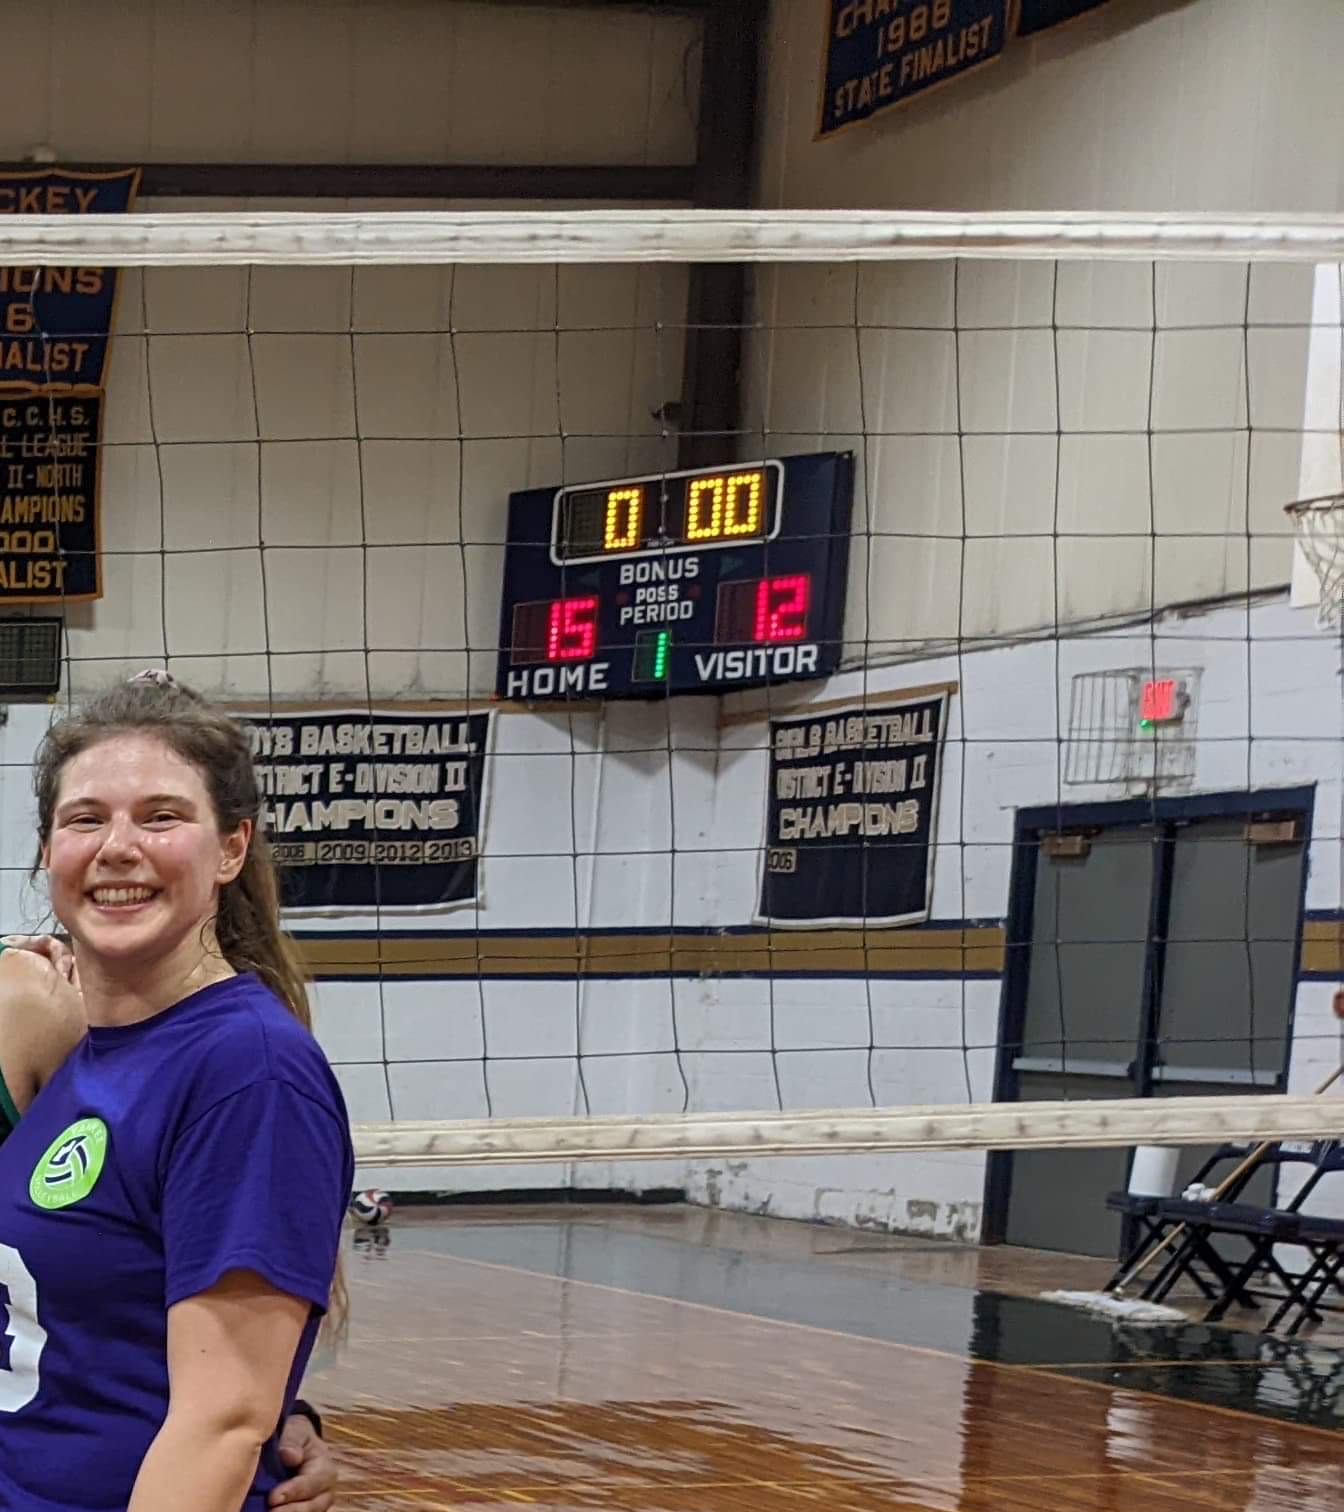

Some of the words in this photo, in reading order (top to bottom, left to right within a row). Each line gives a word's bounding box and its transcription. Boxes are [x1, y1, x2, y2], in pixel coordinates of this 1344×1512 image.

[833, 63, 894, 117] STATE
[900, 15, 993, 87] FINALIST
[22, 432, 90, 458] LEAGUE
[619, 557, 699, 585] BONUS
[635, 585, 679, 604] POSS
[755, 575, 810, 641] 12
[548, 598, 596, 659] 15
[620, 601, 693, 625] PERIOD
[654, 631, 669, 678] 1
[694, 645, 819, 681] VISITOR
[507, 662, 610, 697] HOME
[301, 724, 476, 755] BASKETBALL
[775, 721, 822, 761] GIRLS
[823, 709, 934, 755] BASKETBALL
[263, 799, 459, 832] HAMPIONS
[779, 799, 919, 840] CHAMPIONS
